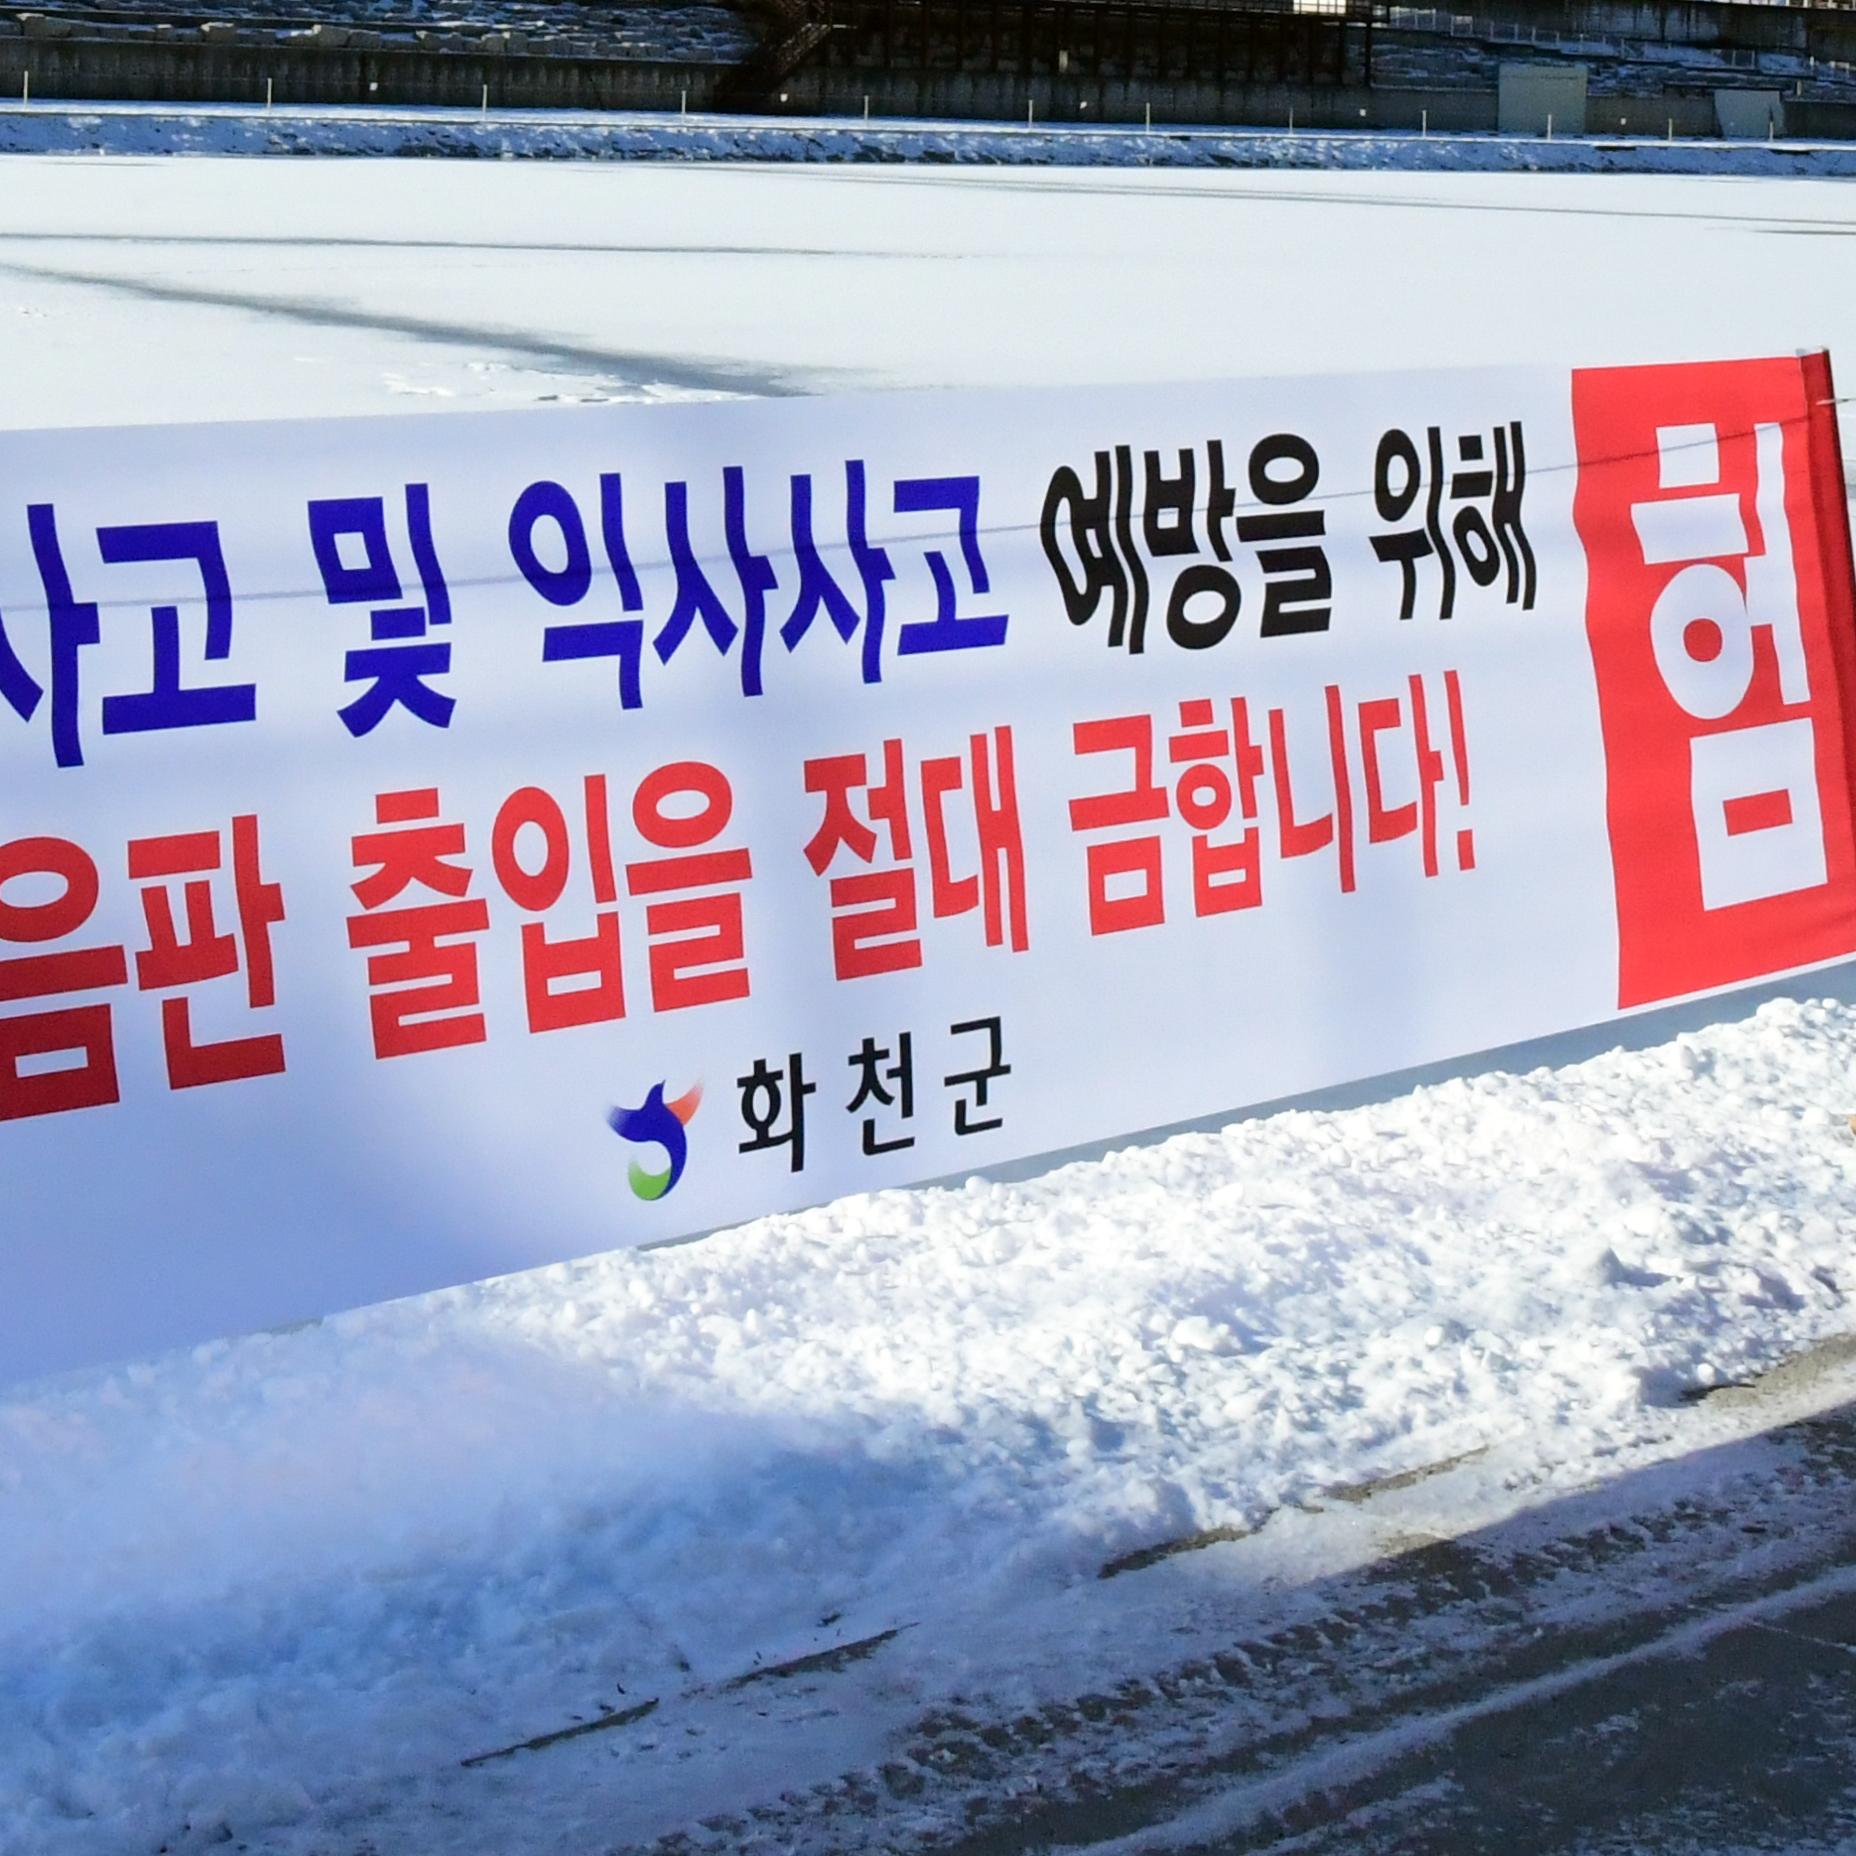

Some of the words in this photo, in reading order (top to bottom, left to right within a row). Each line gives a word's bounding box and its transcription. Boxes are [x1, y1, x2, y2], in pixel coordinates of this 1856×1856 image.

[308, 484, 456, 737] 및
[507, 461, 1008, 710] 익사사고
[1040, 434, 1332, 654] 예방을
[1369, 421, 1537, 620] 위해
[1631, 422, 1828, 911] 험
[347, 762, 752, 1059] 출입을
[804, 726, 1029, 980] 절대
[1068, 669, 1476, 936] 금합니다!
